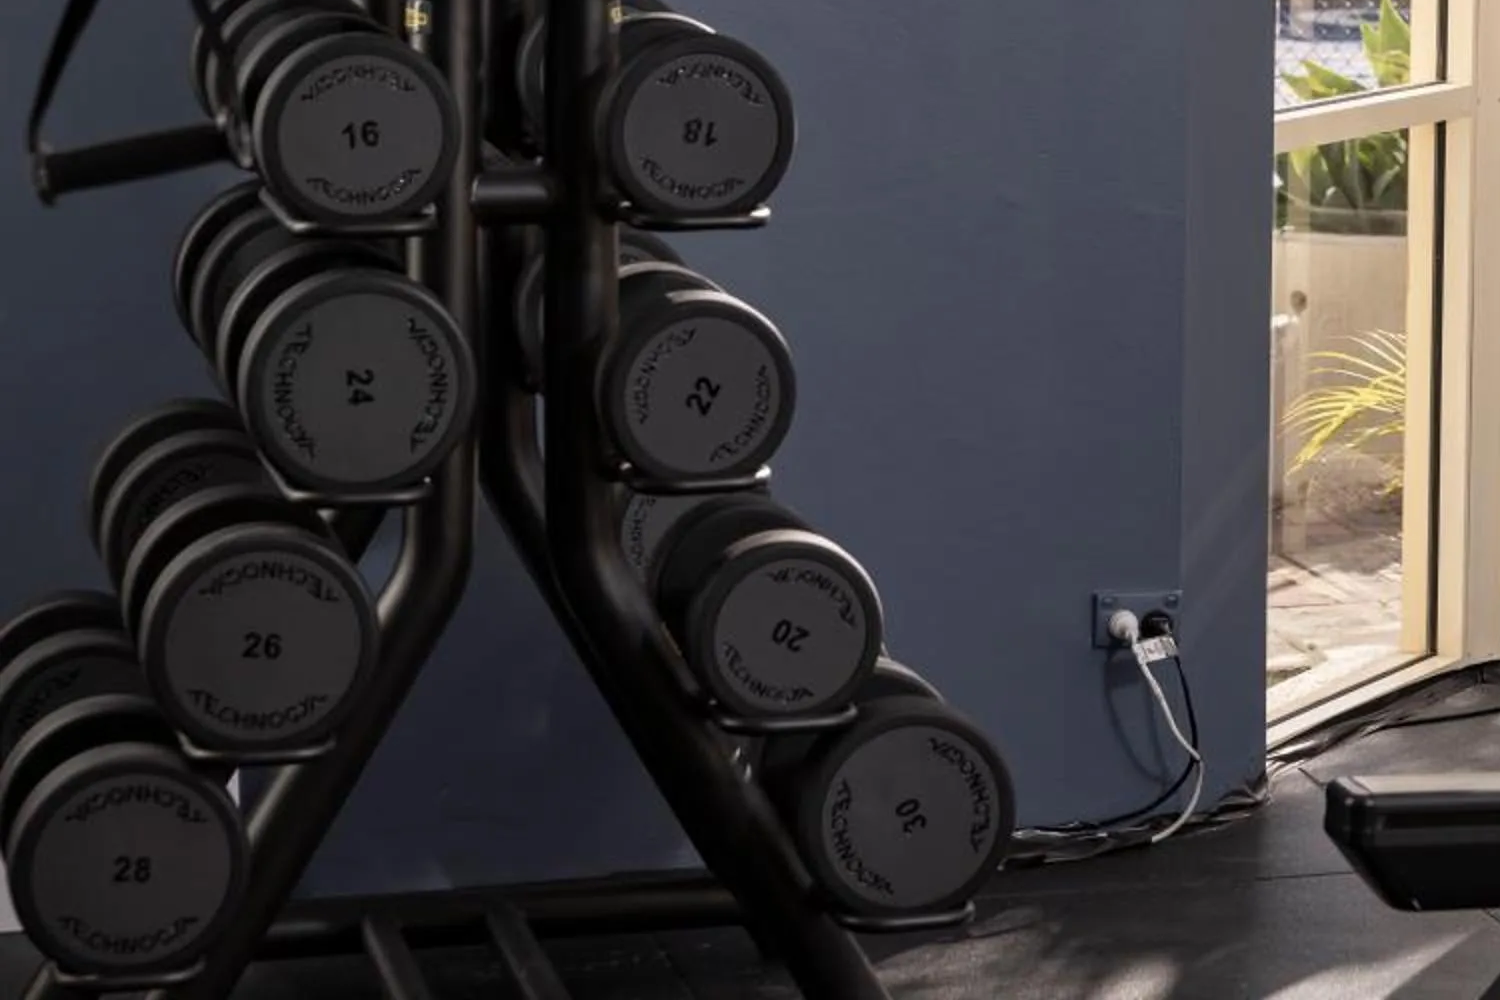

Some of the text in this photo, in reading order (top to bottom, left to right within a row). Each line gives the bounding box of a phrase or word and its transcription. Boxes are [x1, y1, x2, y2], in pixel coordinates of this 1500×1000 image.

[341, 119, 380, 149] 16
[683, 117, 718, 148] 18
[345, 368, 375, 407] 24
[685, 376, 721, 417] 22
[241, 632, 282, 661] 26
[771, 618, 810, 653] 20
[894, 798, 928, 835] 30
[111, 855, 152, 885] 28
